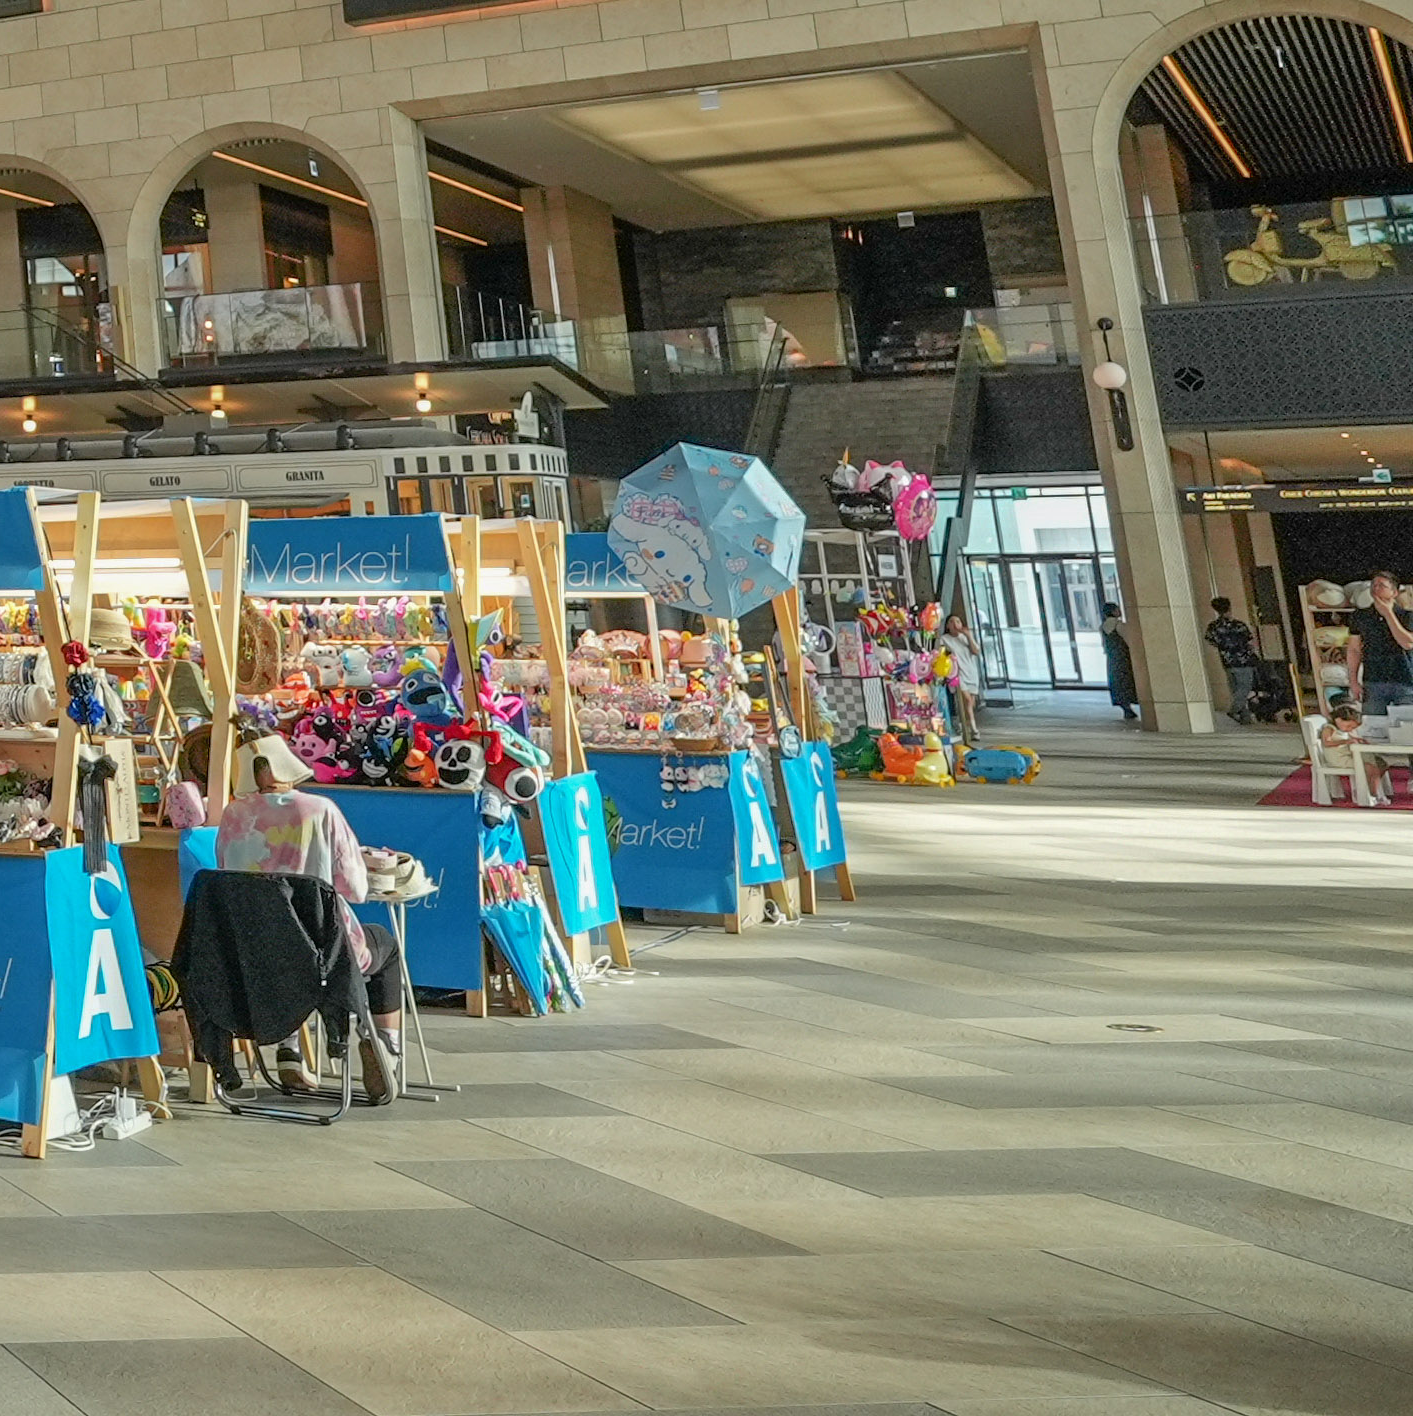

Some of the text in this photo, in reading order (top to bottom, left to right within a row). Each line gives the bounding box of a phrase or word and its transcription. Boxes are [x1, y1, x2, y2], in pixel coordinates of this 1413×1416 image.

[149, 475, 181, 486] GELATO
[285, 469, 324, 482] GRANITA
[250, 533, 410, 584] Market!
